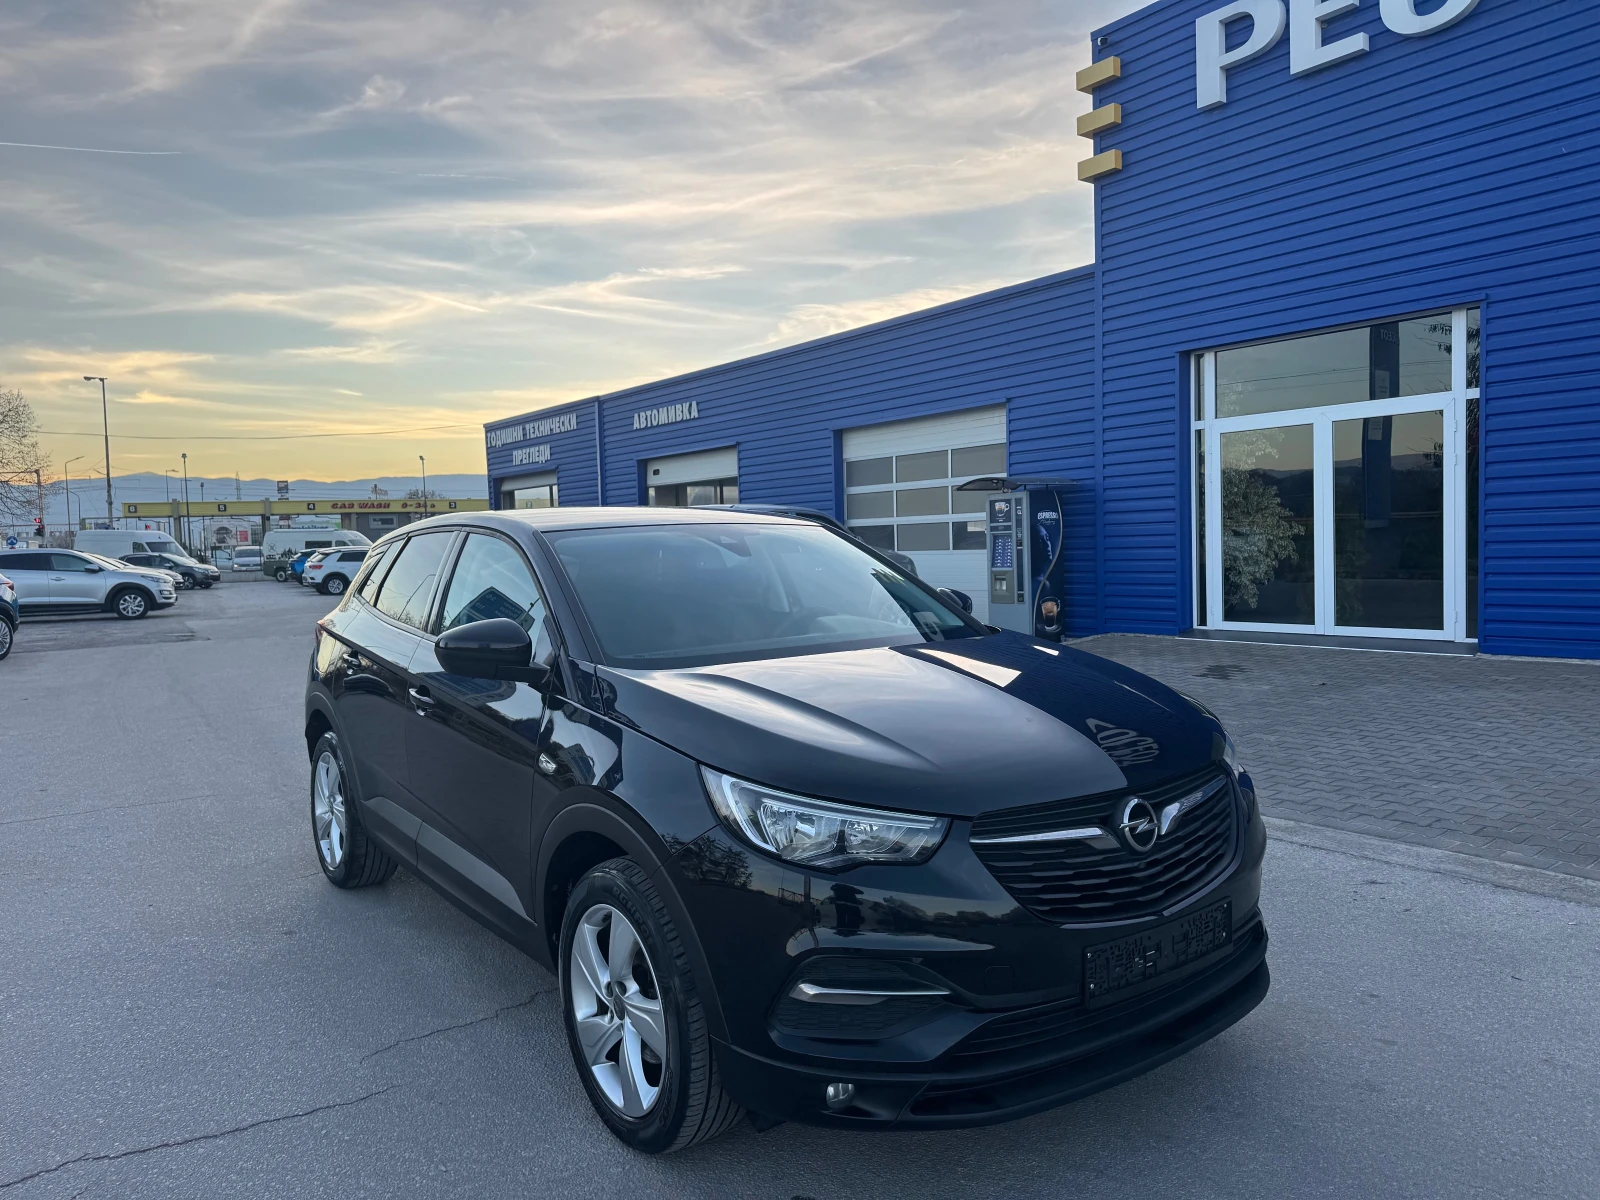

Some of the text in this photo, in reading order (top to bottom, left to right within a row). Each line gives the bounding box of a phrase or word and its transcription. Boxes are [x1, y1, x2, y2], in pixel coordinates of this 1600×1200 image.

[487, 413, 577, 447] ГОДИШНИ ТЕХНИЧЕСКИ
[634, 401, 698, 430] АВТОМИВКА
[512, 444, 551, 465] ПРЕГЛЕДИ
